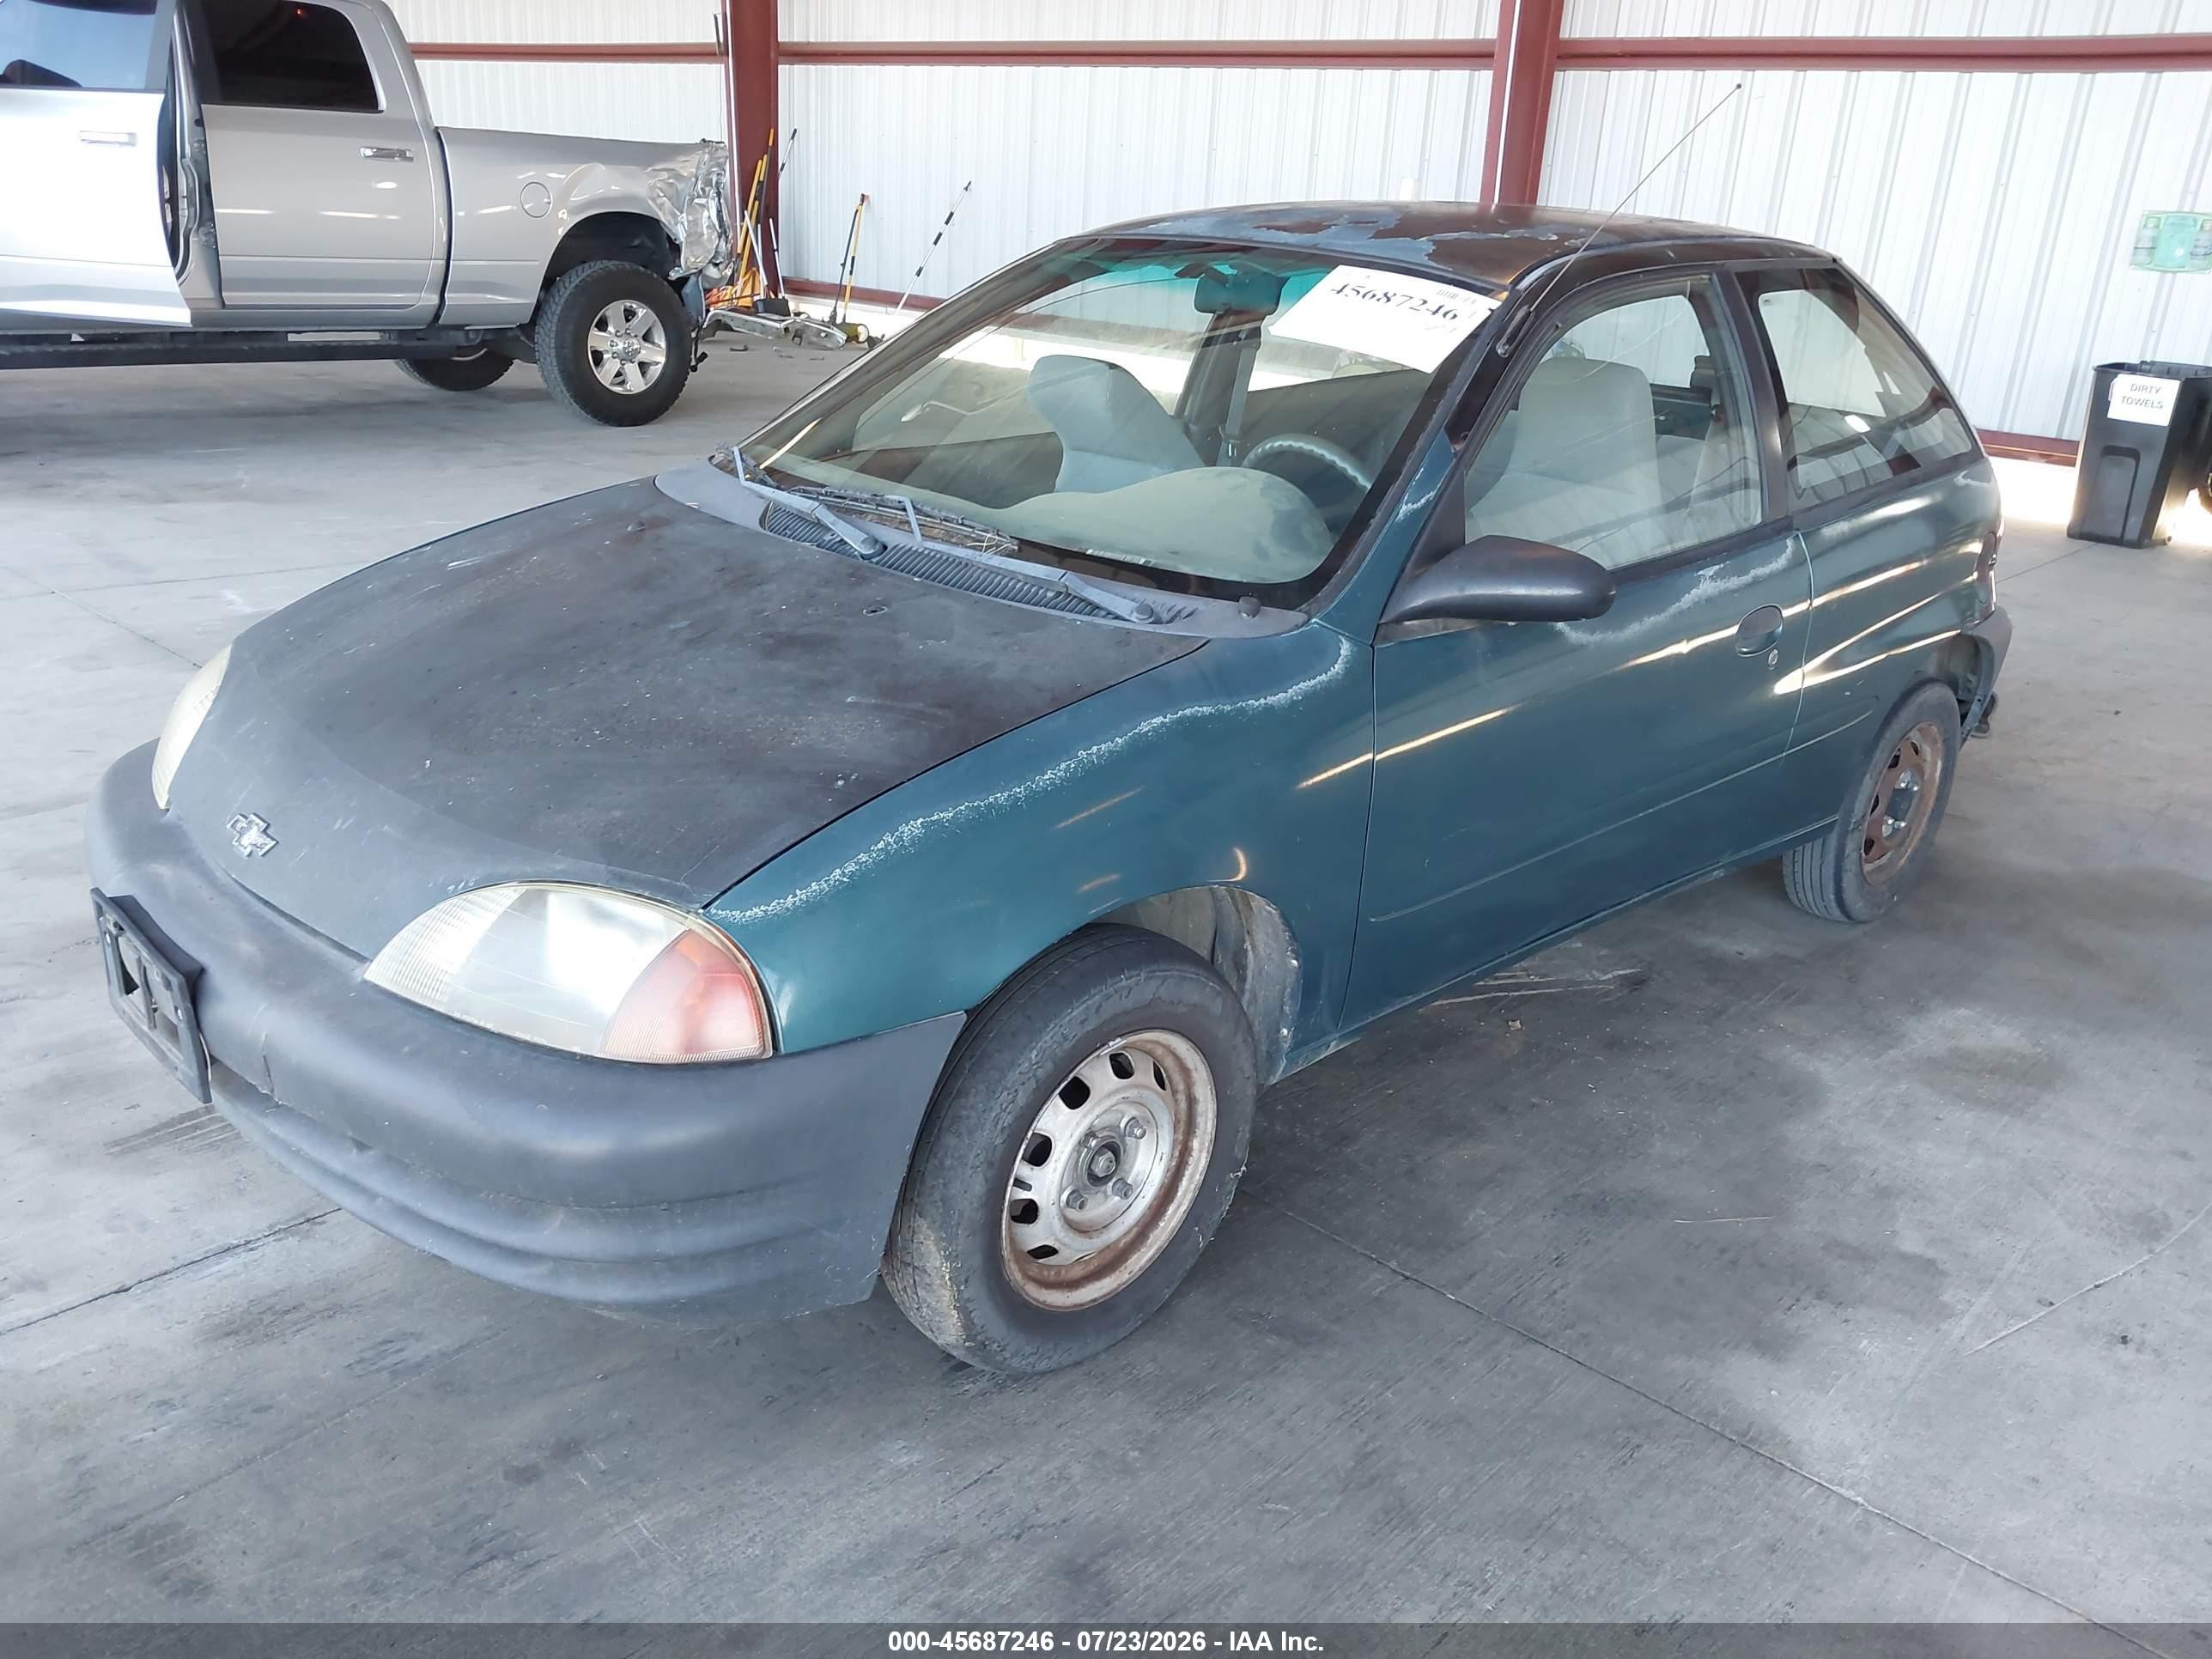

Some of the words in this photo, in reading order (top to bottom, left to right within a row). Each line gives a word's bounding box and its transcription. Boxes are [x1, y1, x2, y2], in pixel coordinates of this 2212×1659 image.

[1330, 282, 1459, 320] 45687246
[2130, 383, 2162, 395] DIRTY
[2121, 395, 2164, 410] TOWELS
